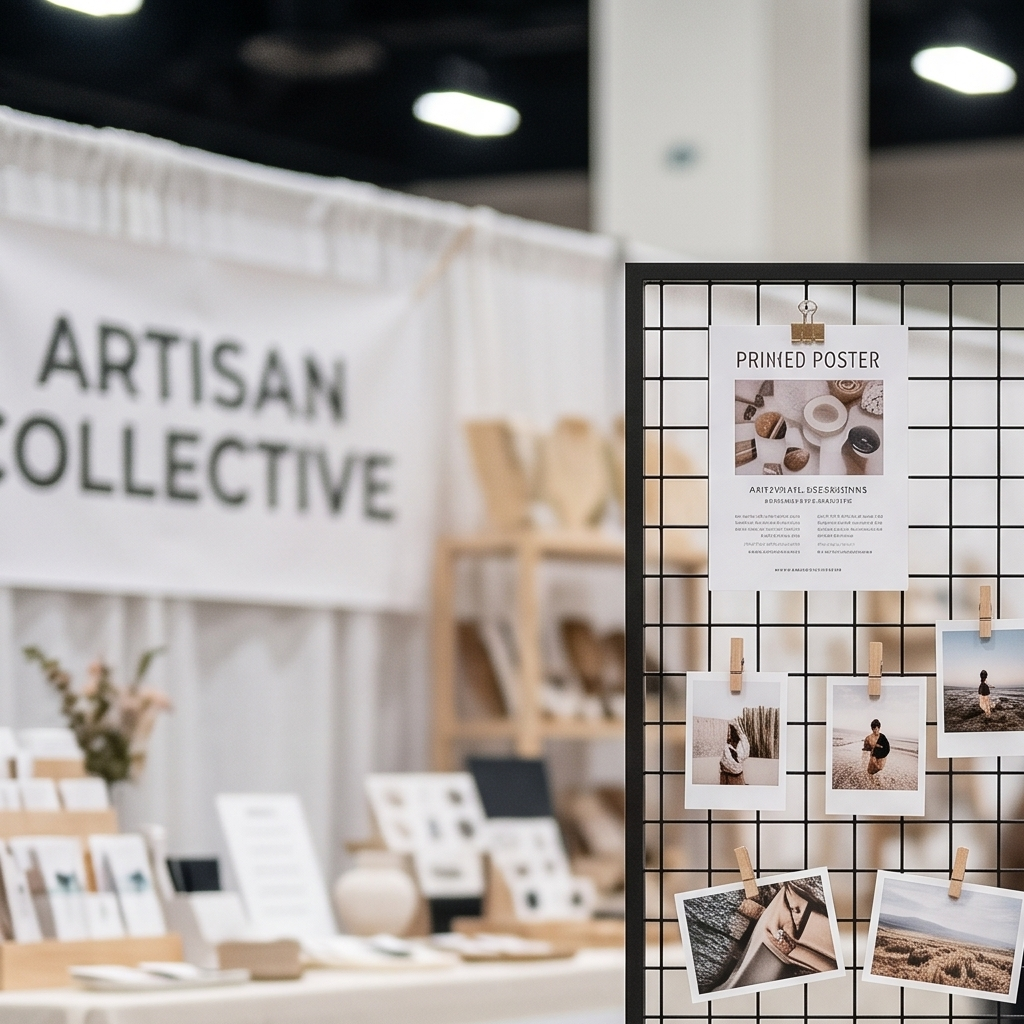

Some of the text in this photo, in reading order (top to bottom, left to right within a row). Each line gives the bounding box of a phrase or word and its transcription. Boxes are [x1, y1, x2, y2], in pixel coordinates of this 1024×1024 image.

[37, 312, 346, 423] ARTISAN
[813, 351, 880, 369] POSTER
[0, 411, 396, 521] OLLECTIVE
